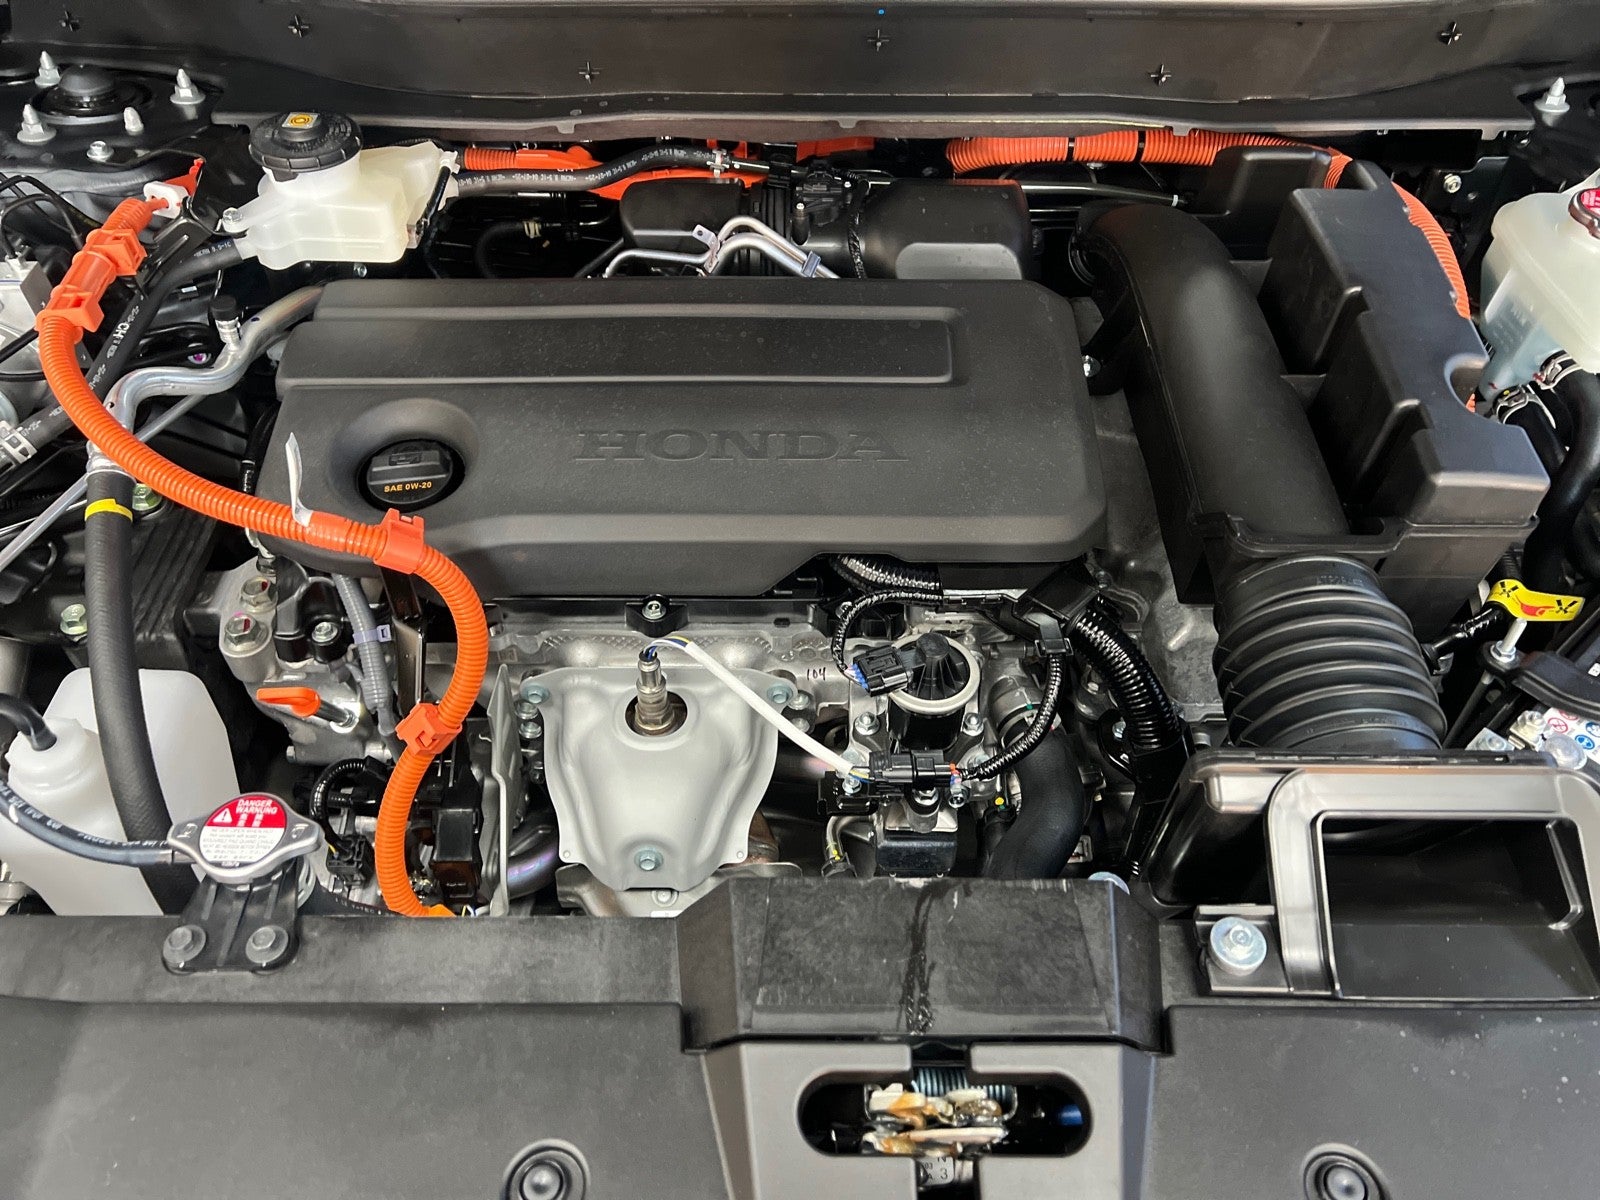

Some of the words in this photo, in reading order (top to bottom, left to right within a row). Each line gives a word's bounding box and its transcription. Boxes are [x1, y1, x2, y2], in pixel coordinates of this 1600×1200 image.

[575, 430, 909, 462] HONDA
[383, 484, 403, 493] SAE
[405, 481, 432, 490] 0W-20
[806, 666, 826, 681] 104
[238, 799, 273, 807] DANGER
[235, 806, 278, 815] WARNUNG
